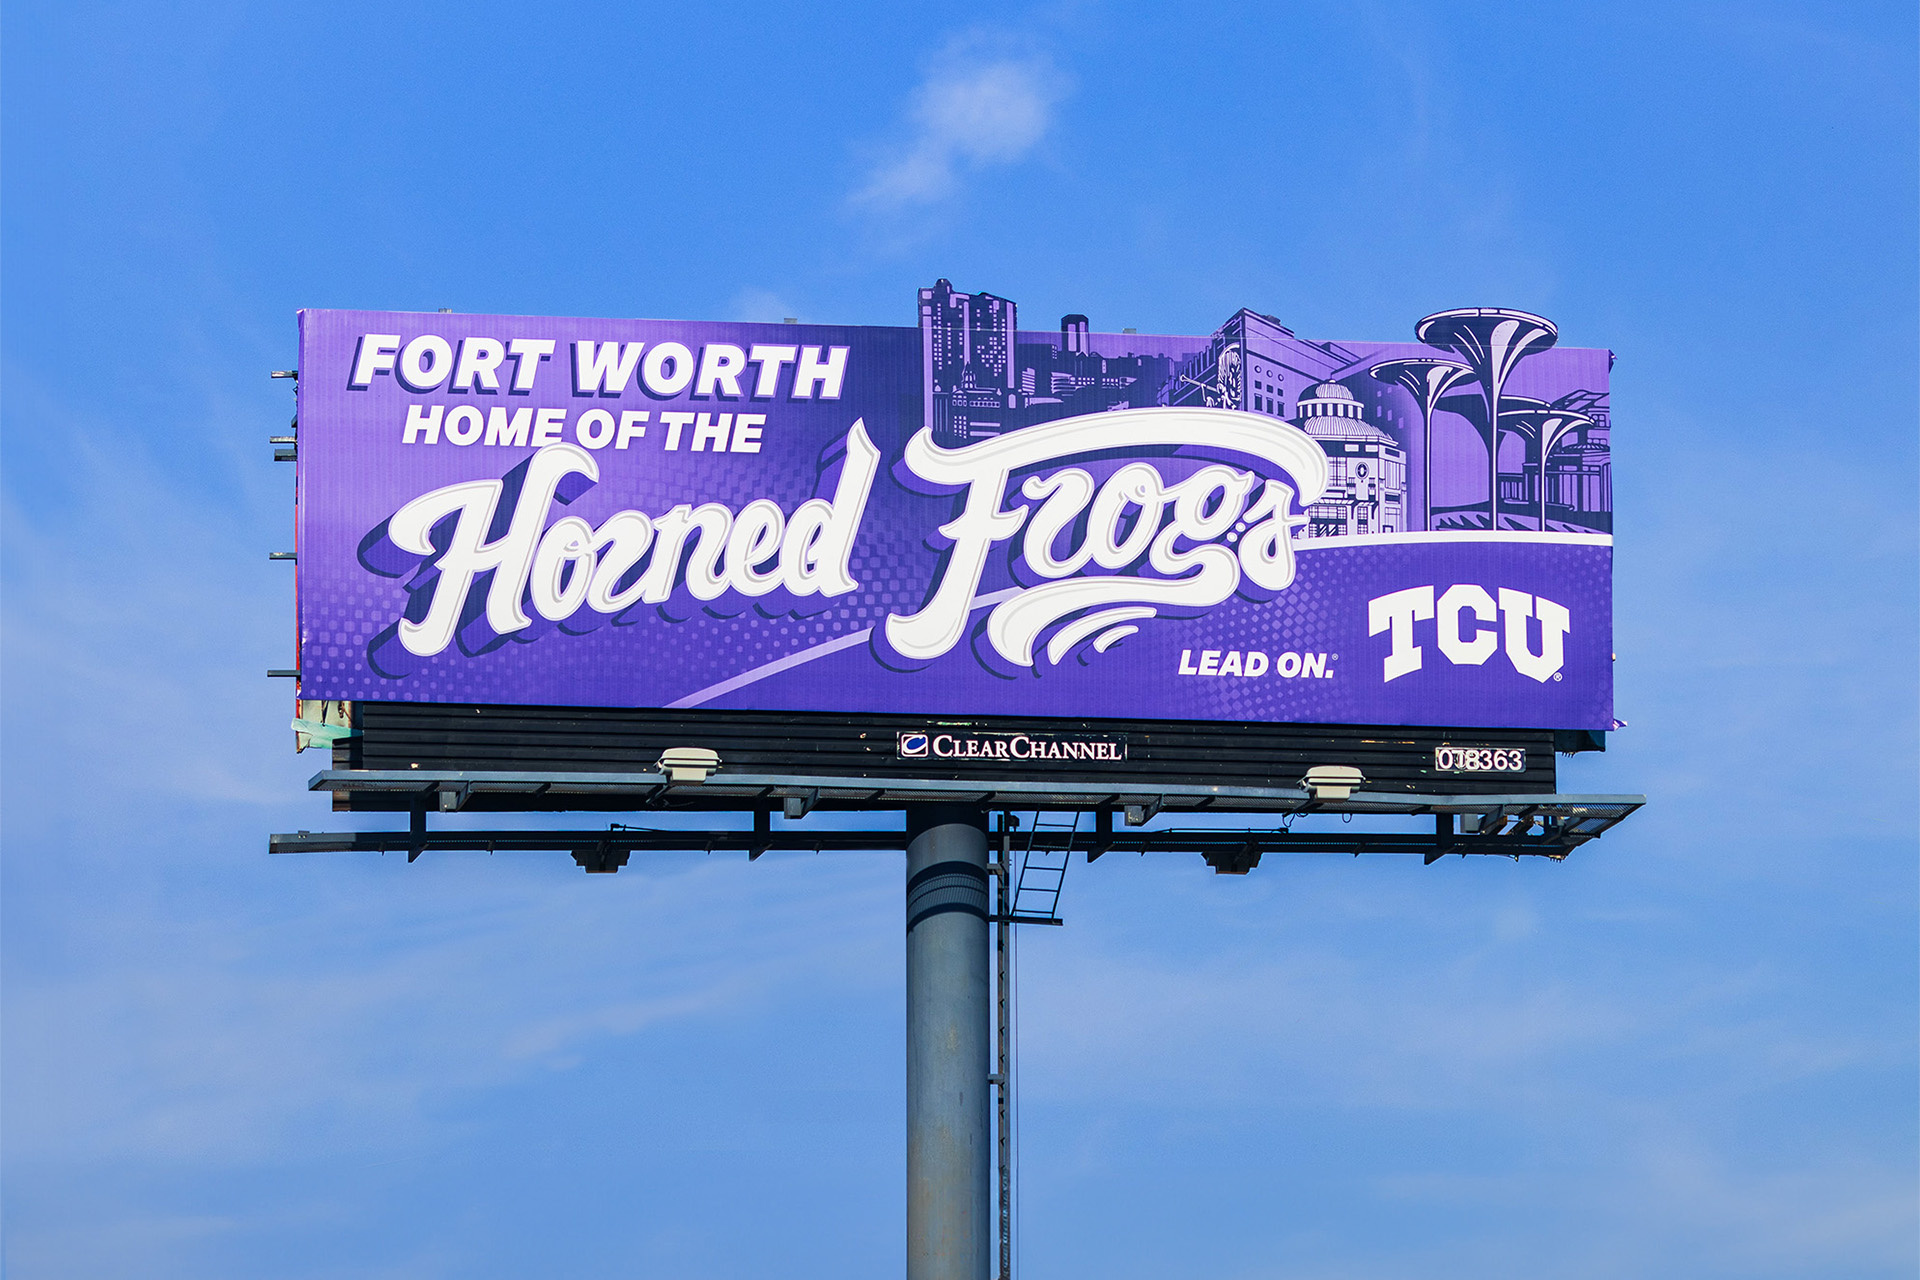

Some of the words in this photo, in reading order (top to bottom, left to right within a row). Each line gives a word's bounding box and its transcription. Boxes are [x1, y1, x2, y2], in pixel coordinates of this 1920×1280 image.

[354, 333, 556, 391] FORT
[575, 340, 850, 400] WORTH
[402, 405, 567, 449] HOME
[575, 409, 648, 450] OF
[657, 412, 767, 453] THE
[388, 417, 881, 656] Horned
[886, 407, 1329, 666] Frogs
[1178, 650, 1269, 677] LEAD
[1368, 584, 1570, 683] TCU
